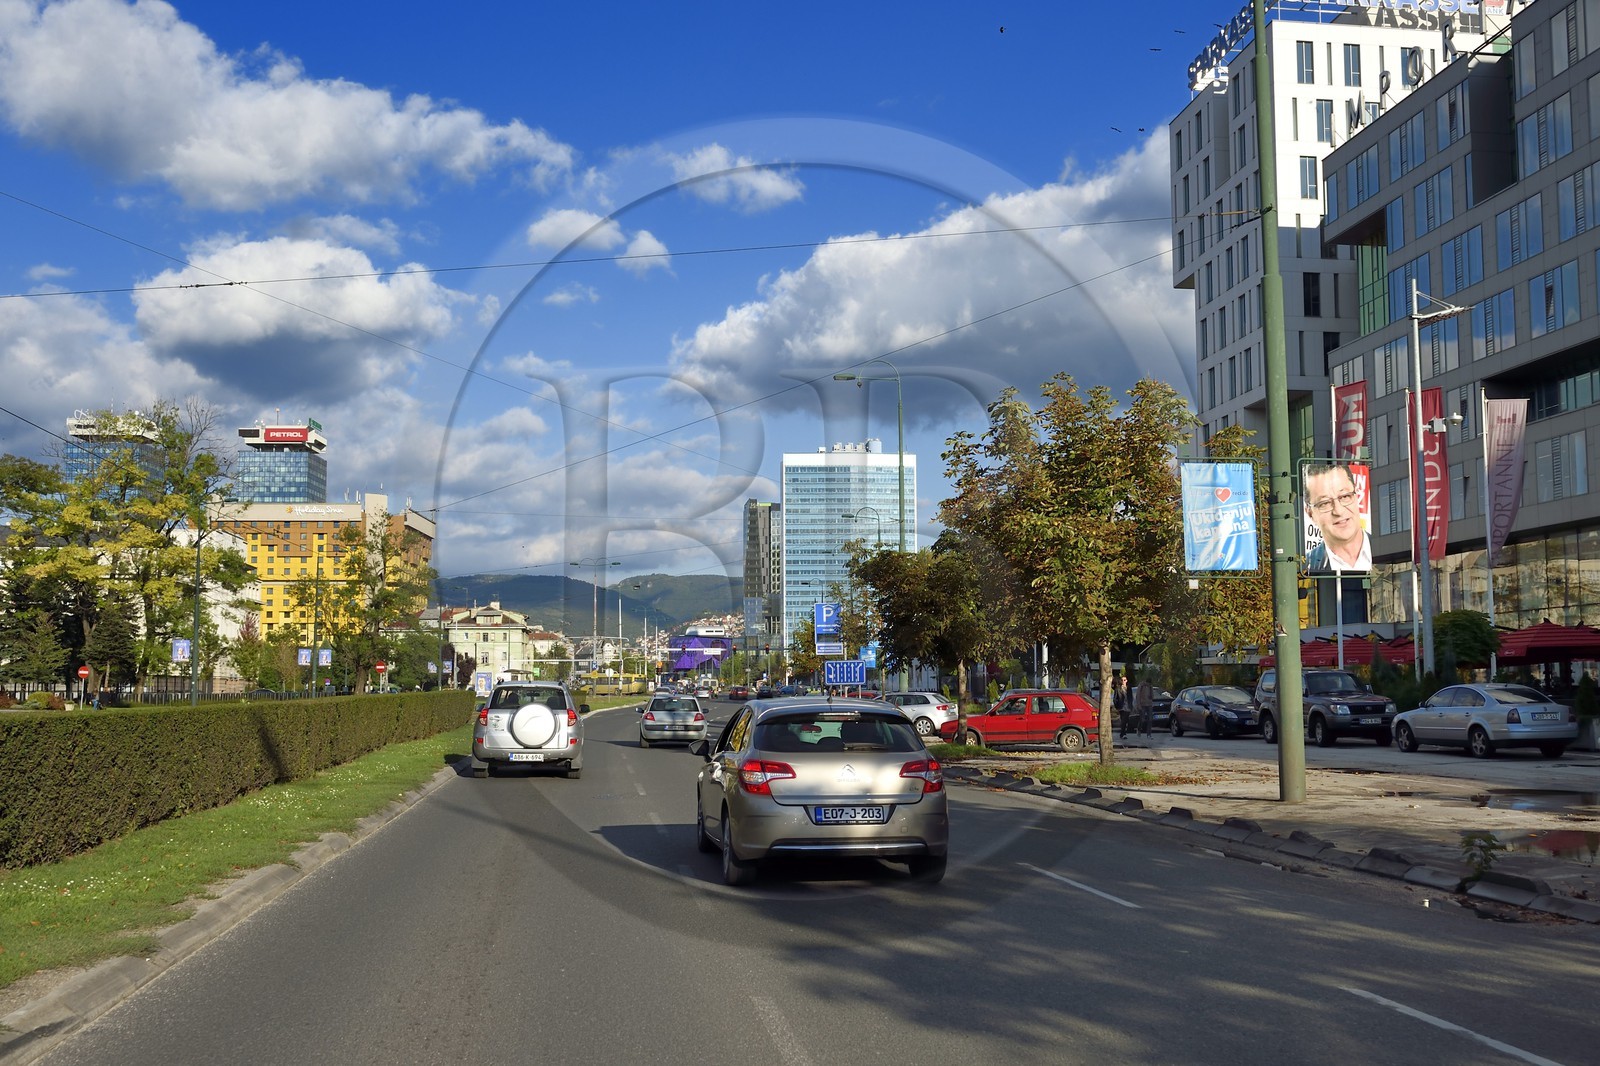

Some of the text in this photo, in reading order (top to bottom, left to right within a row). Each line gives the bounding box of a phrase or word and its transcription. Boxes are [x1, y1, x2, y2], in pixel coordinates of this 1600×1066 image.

[1424, 416, 1442, 541] LINDE
[294, 505, 344, 516] Holiday Inn
[823, 606, 834, 622] P
[823, 808, 882, 819] E07-J-203
